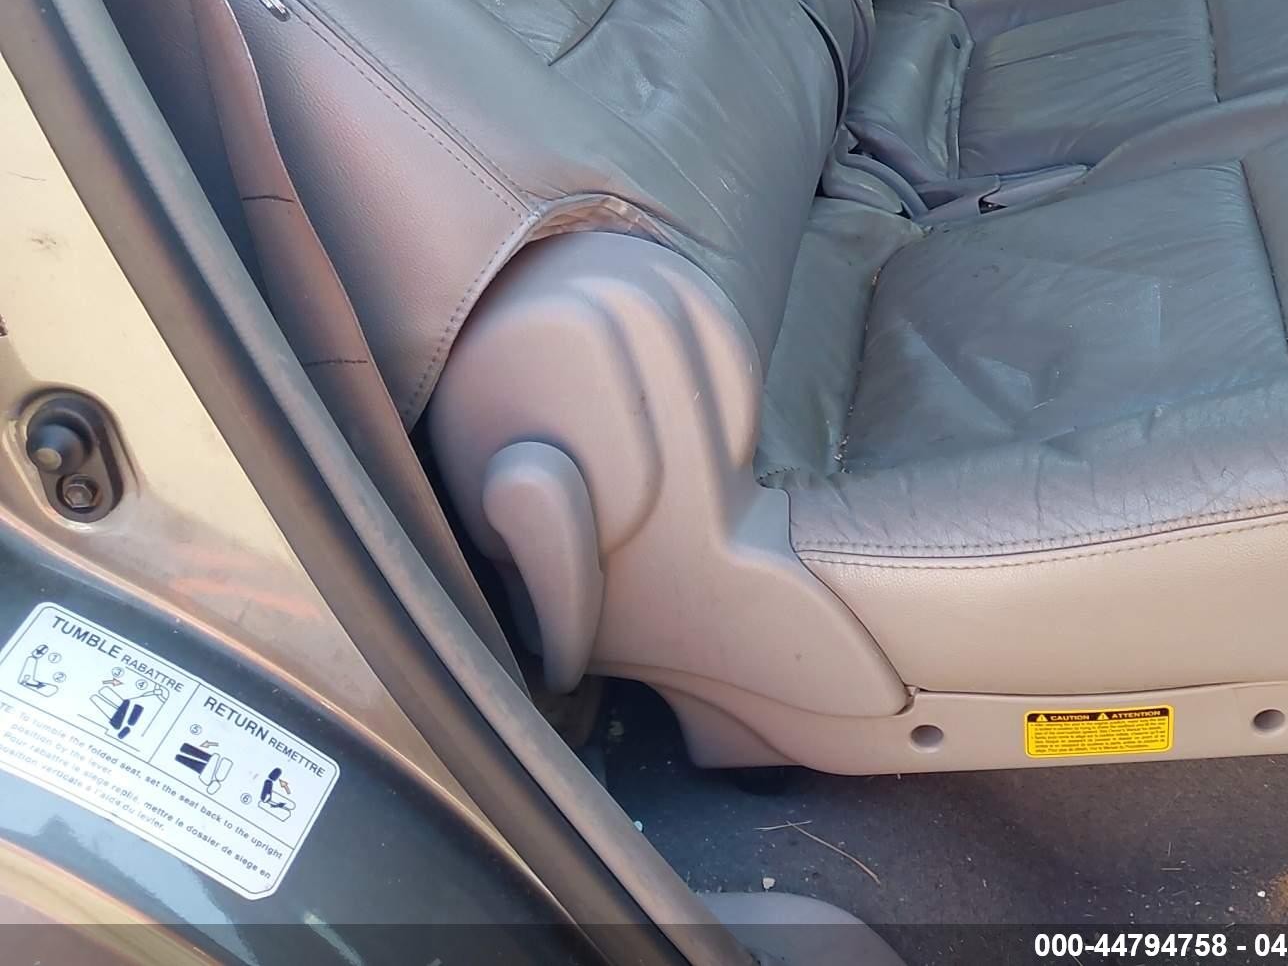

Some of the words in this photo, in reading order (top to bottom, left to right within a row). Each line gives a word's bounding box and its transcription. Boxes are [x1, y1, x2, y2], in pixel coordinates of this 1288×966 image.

[51, 616, 123, 659] TUMBLE
[121, 654, 185, 693] RABATTRE
[203, 696, 270, 742] RETURN
[268, 737, 327, 778] REMETTRE
[1111, 710, 1161, 719] ATTENTION
[88, 744, 119, 765] folded
[120, 762, 142, 779] seat,
[145, 775, 161, 788] set
[162, 784, 177, 797] the
[178, 794, 200, 810] seat
[200, 805, 222, 823] back
[223, 819, 234, 830] to
[234, 825, 249, 839] the
[251, 837, 284, 860] upright
[144, 801, 174, 822] mettre
[175, 817, 185, 827] le
[186, 824, 221, 848] dossier
[221, 845, 233, 856] de
[259, 869, 271, 879] en
